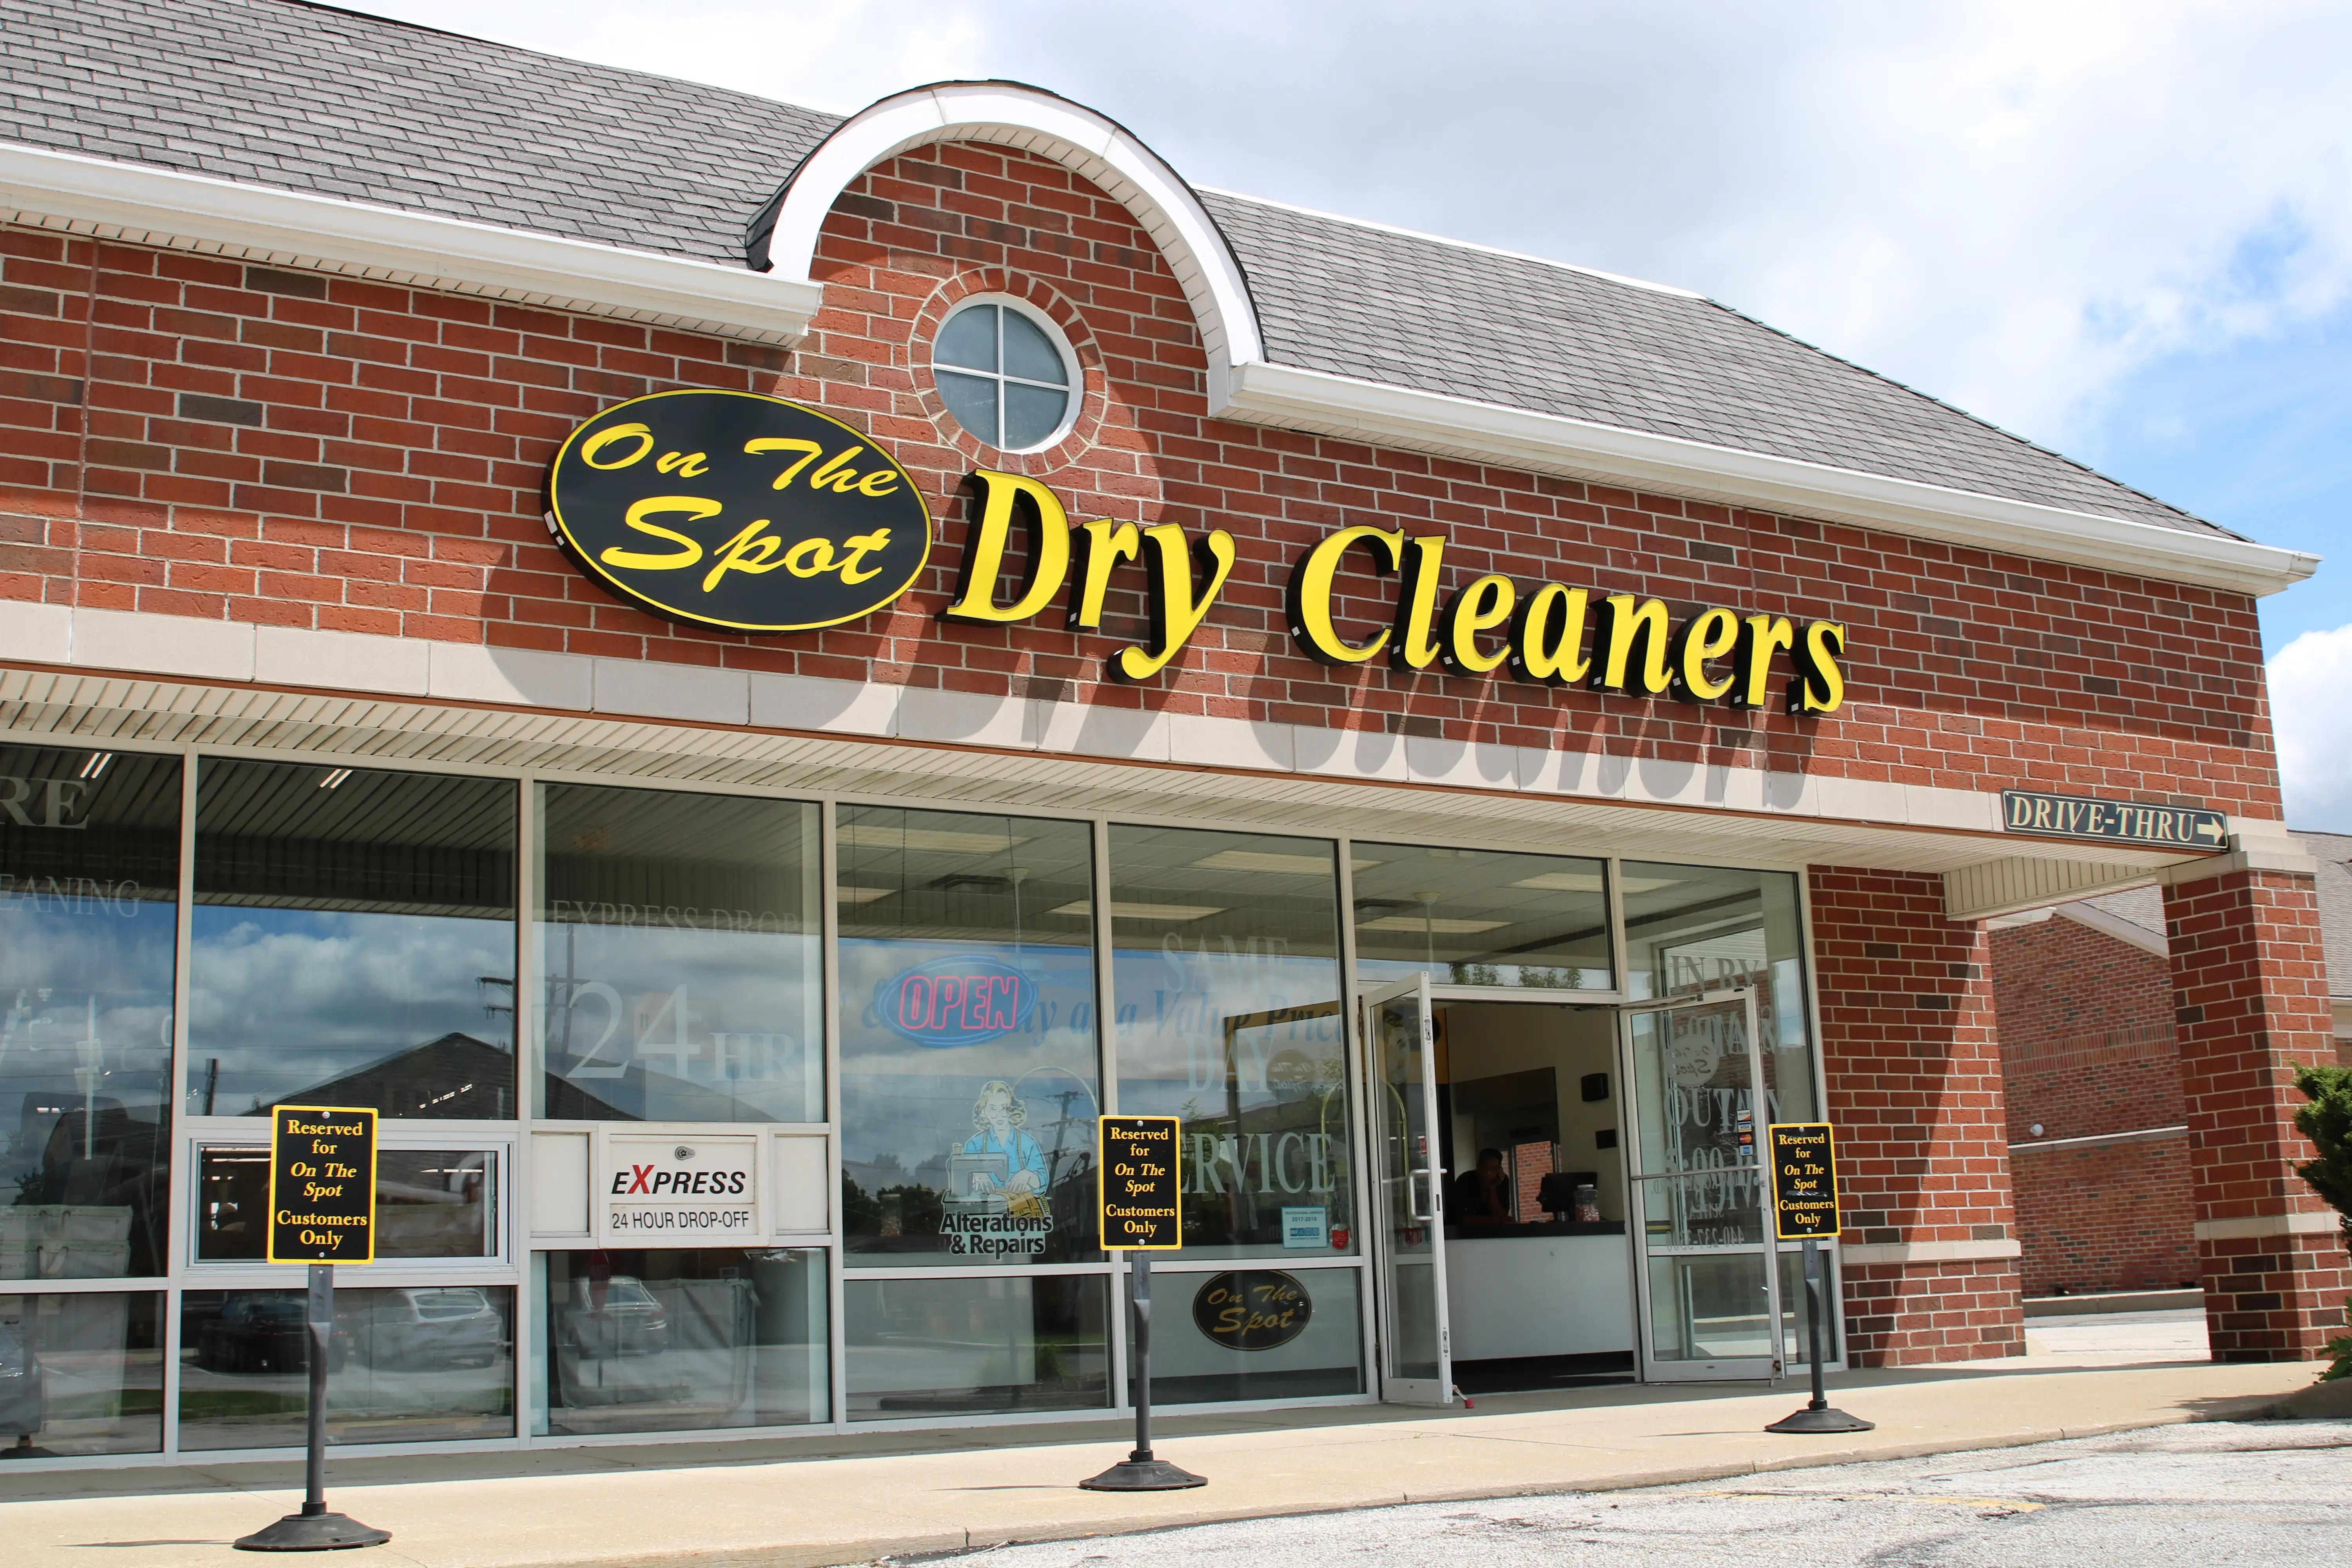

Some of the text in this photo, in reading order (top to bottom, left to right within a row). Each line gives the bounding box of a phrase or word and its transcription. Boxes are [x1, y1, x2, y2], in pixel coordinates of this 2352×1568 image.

[582, 423, 898, 497] On The
[600, 495, 891, 592] Spot
[946, 468, 1846, 713] Dry Cleaners
[2010, 796, 2196, 842] DRIVE-THRU
[550, 900, 799, 942] EXPRESS DROP
[1161, 931, 1289, 993] SAME
[899, 976, 1019, 1029] OPEN
[1154, 990, 1251, 1040] Value
[1261, 994, 1342, 1042] Pric
[566, 981, 801, 1082] 24 HR
[1185, 1032, 1277, 1093] DAY
[287, 1119, 363, 1136] Reserved
[1110, 1127, 1169, 1140] Reserved
[312, 1139, 338, 1154] for
[1778, 1133, 1825, 1145] Reserved
[1130, 1143, 1150, 1156] for
[1795, 1147, 1811, 1158] for
[290, 1161, 357, 1178] On The
[1114, 1163, 1165, 1176] On The
[1181, 1132, 1335, 1194] RVICE
[1784, 1163, 1824, 1176] On The
[611, 1164, 746, 1194] EXPRESS
[1125, 1179, 1156, 1197] Spot
[1794, 1178, 1818, 1192] Spot
[303, 1181, 344, 1202] Spot
[1105, 1203, 1175, 1217] Customers
[1779, 1200, 1835, 1211] Customers
[276, 1209, 368, 1226] Customers
[612, 1211, 749, 1229] 24 HOUR DROP-OFF
[941, 1212, 1053, 1232] Alterations
[1795, 1212, 1821, 1227] Only
[1124, 1220, 1157, 1238] Only
[300, 1229, 344, 1250] Only
[950, 1234, 1044, 1259] & Repairs
[1207, 1284, 1298, 1305] On The
[1212, 1306, 1294, 1332] Spot
